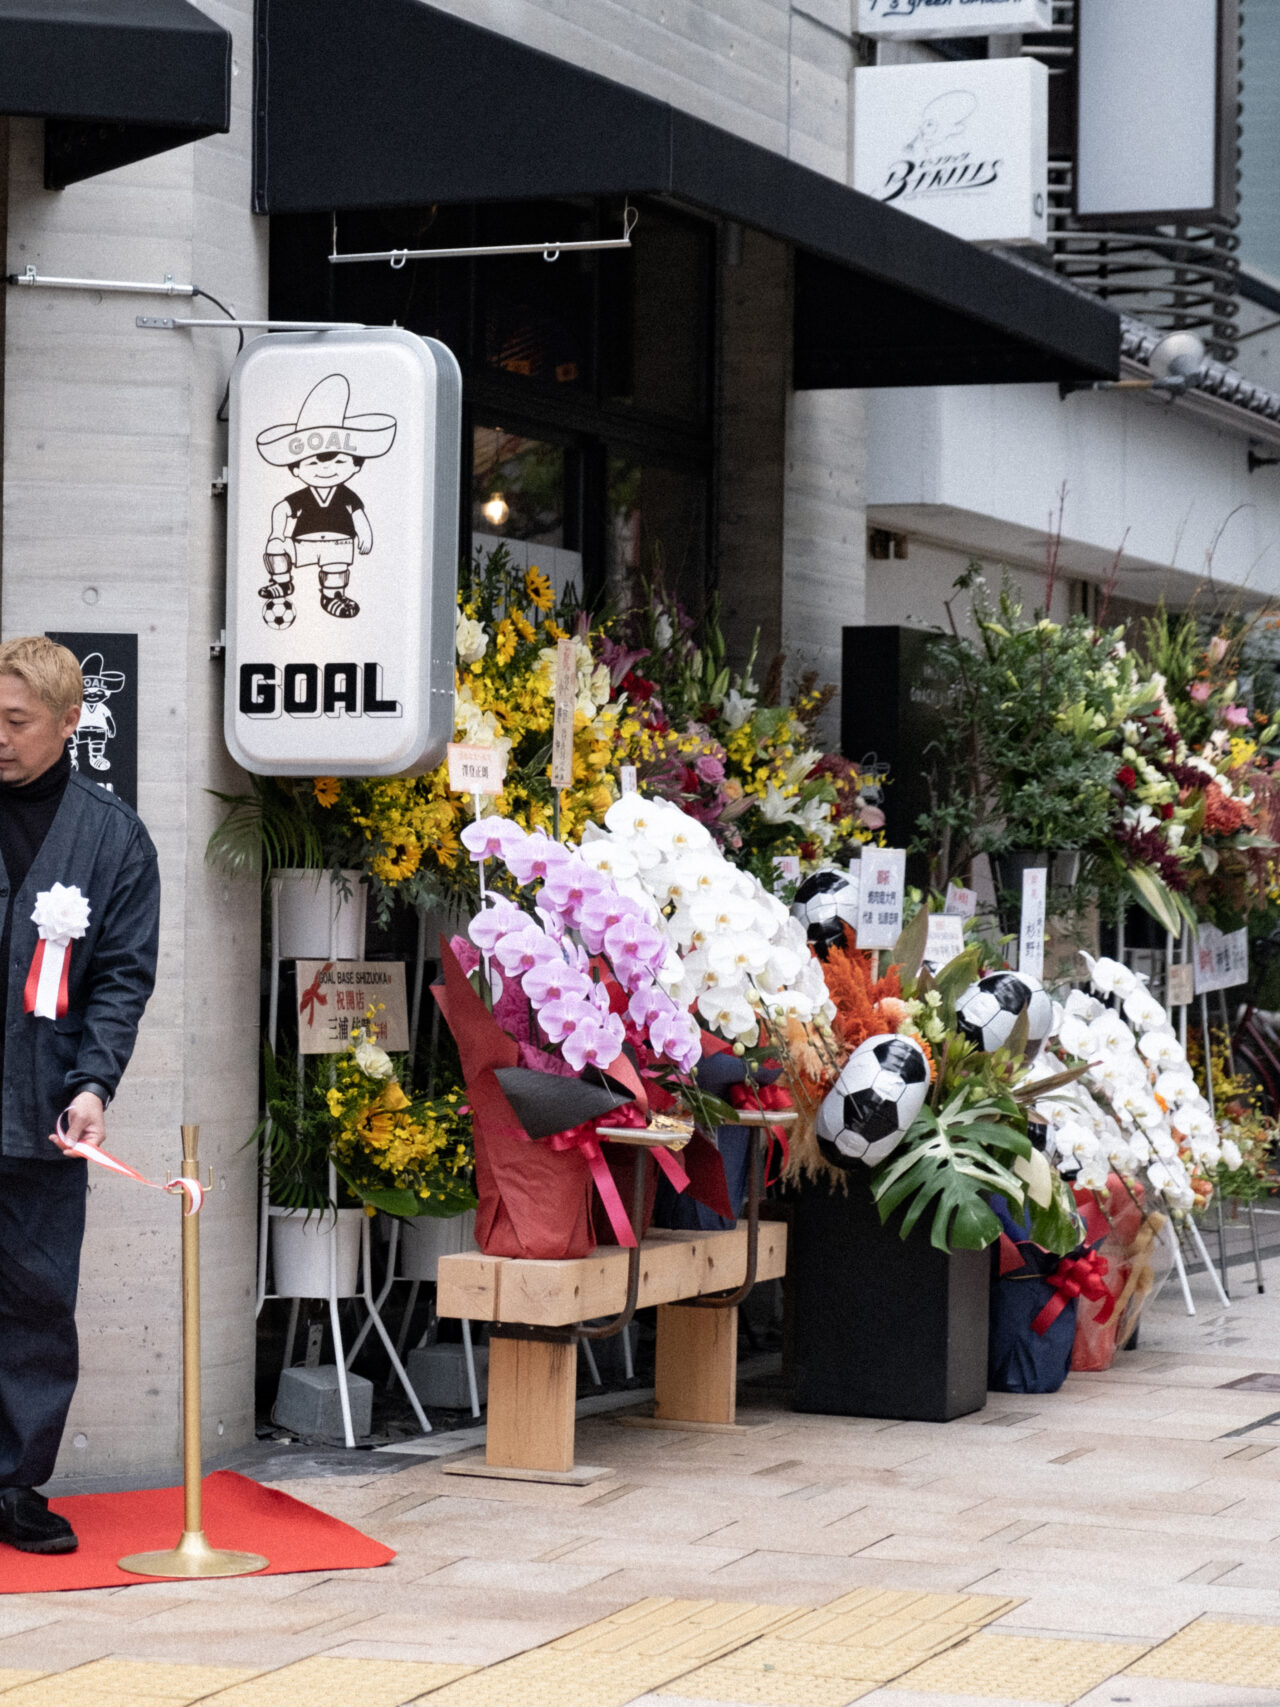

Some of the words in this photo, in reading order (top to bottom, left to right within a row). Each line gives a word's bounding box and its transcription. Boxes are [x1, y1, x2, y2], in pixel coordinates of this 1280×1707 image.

[288, 431, 358, 455] GOAL
[83, 677, 108, 689] OAL
[240, 662, 403, 719] GOAL
[319, 971, 335, 985] GOAL
[337, 972, 355, 985] BASE
[356, 972, 387, 985] SHIZUOKA
